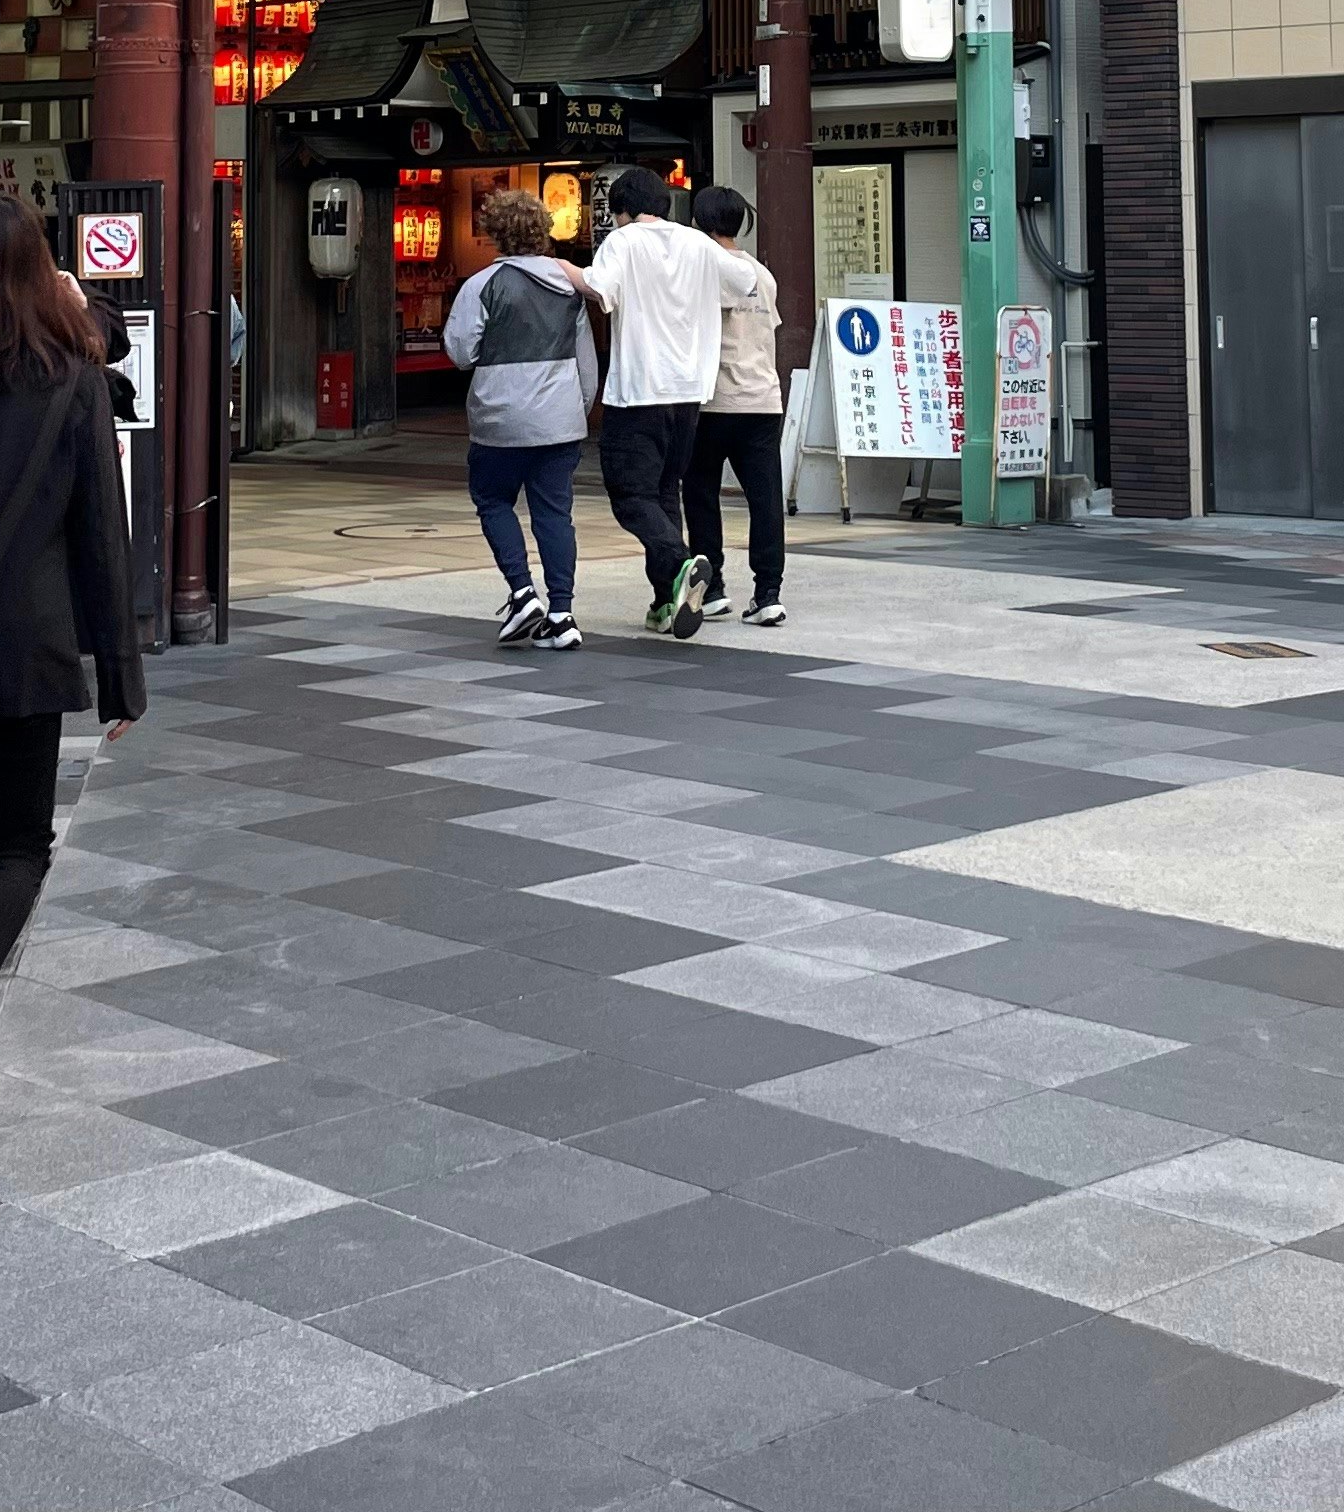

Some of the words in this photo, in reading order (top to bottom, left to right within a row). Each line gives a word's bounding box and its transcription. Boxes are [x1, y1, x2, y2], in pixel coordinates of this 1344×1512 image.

[566, 99, 623, 120] 矢田寺
[566, 121, 624, 136] YATA-DERA
[888, 306, 916, 446] 自転車は押して下さい
[1001, 379, 1046, 394] この付近に
[862, 367, 880, 452] 中京警察署
[1001, 396, 1038, 411] 自転車を
[1000, 413, 1046, 428] 止めないで
